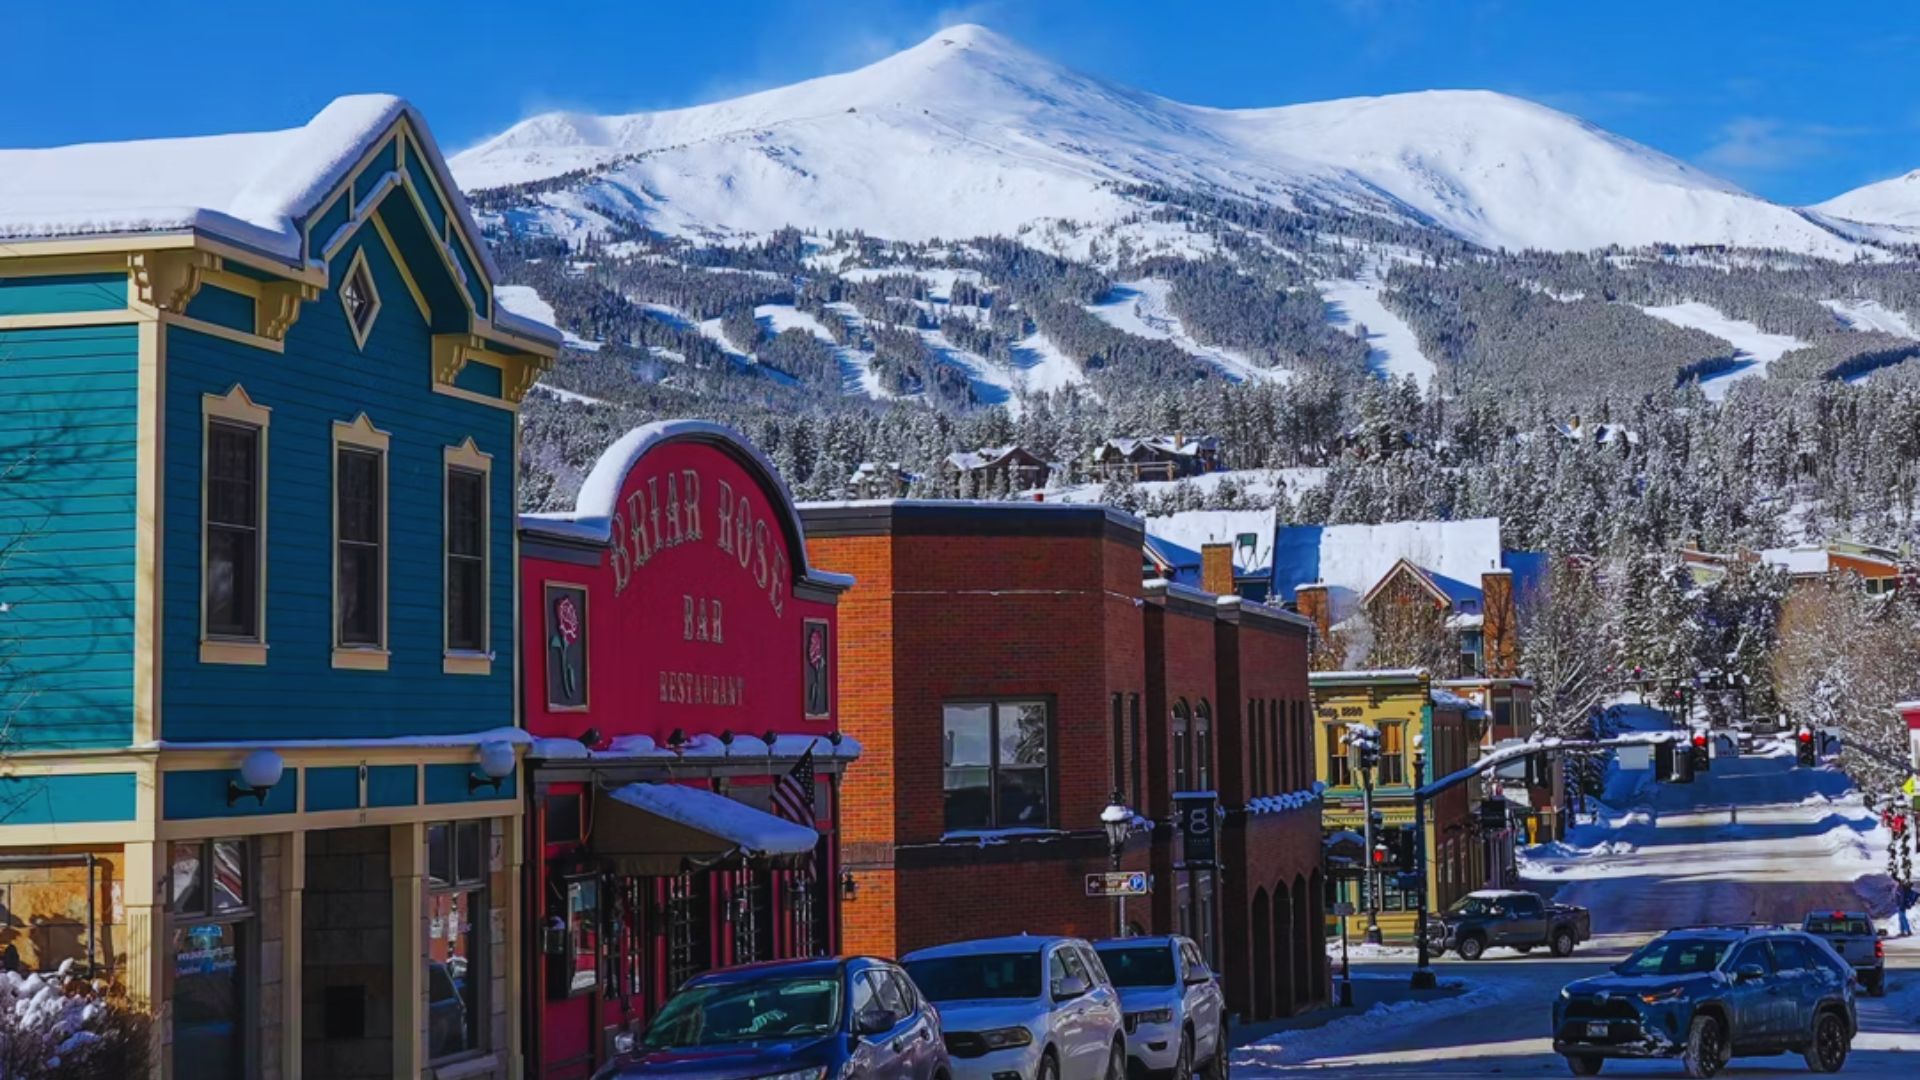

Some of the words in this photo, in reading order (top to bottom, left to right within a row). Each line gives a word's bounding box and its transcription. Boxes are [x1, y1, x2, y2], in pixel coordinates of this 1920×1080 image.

[610, 470, 702, 597] BRIAR
[717, 479, 786, 618] ROSE
[683, 594, 724, 644] BAR
[659, 671, 744, 706] RESTAURANT
